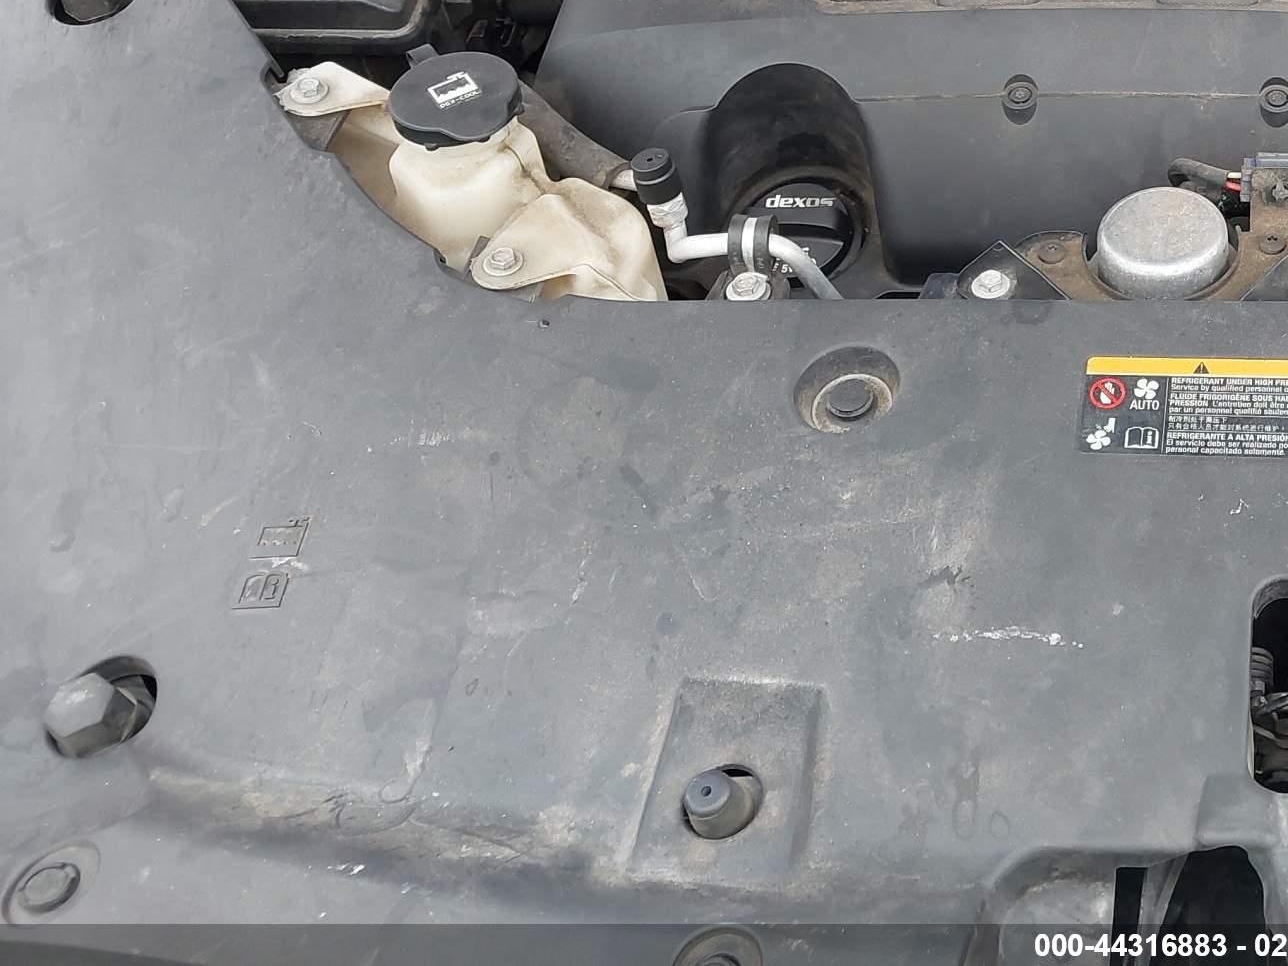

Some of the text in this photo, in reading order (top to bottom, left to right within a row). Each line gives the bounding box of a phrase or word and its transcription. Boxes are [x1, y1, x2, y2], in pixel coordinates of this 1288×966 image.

[765, 194, 837, 208] dexos
[1226, 378, 1252, 386] UNDER
[1212, 385, 1243, 393] qualified
[1129, 400, 1160, 410] AUTO
[1195, 407, 1232, 415] personnel
[1167, 432, 1225, 440] REFRIGERANTE
[1166, 447, 1199, 455] personal
[1200, 448, 1242, 456] capacitado
